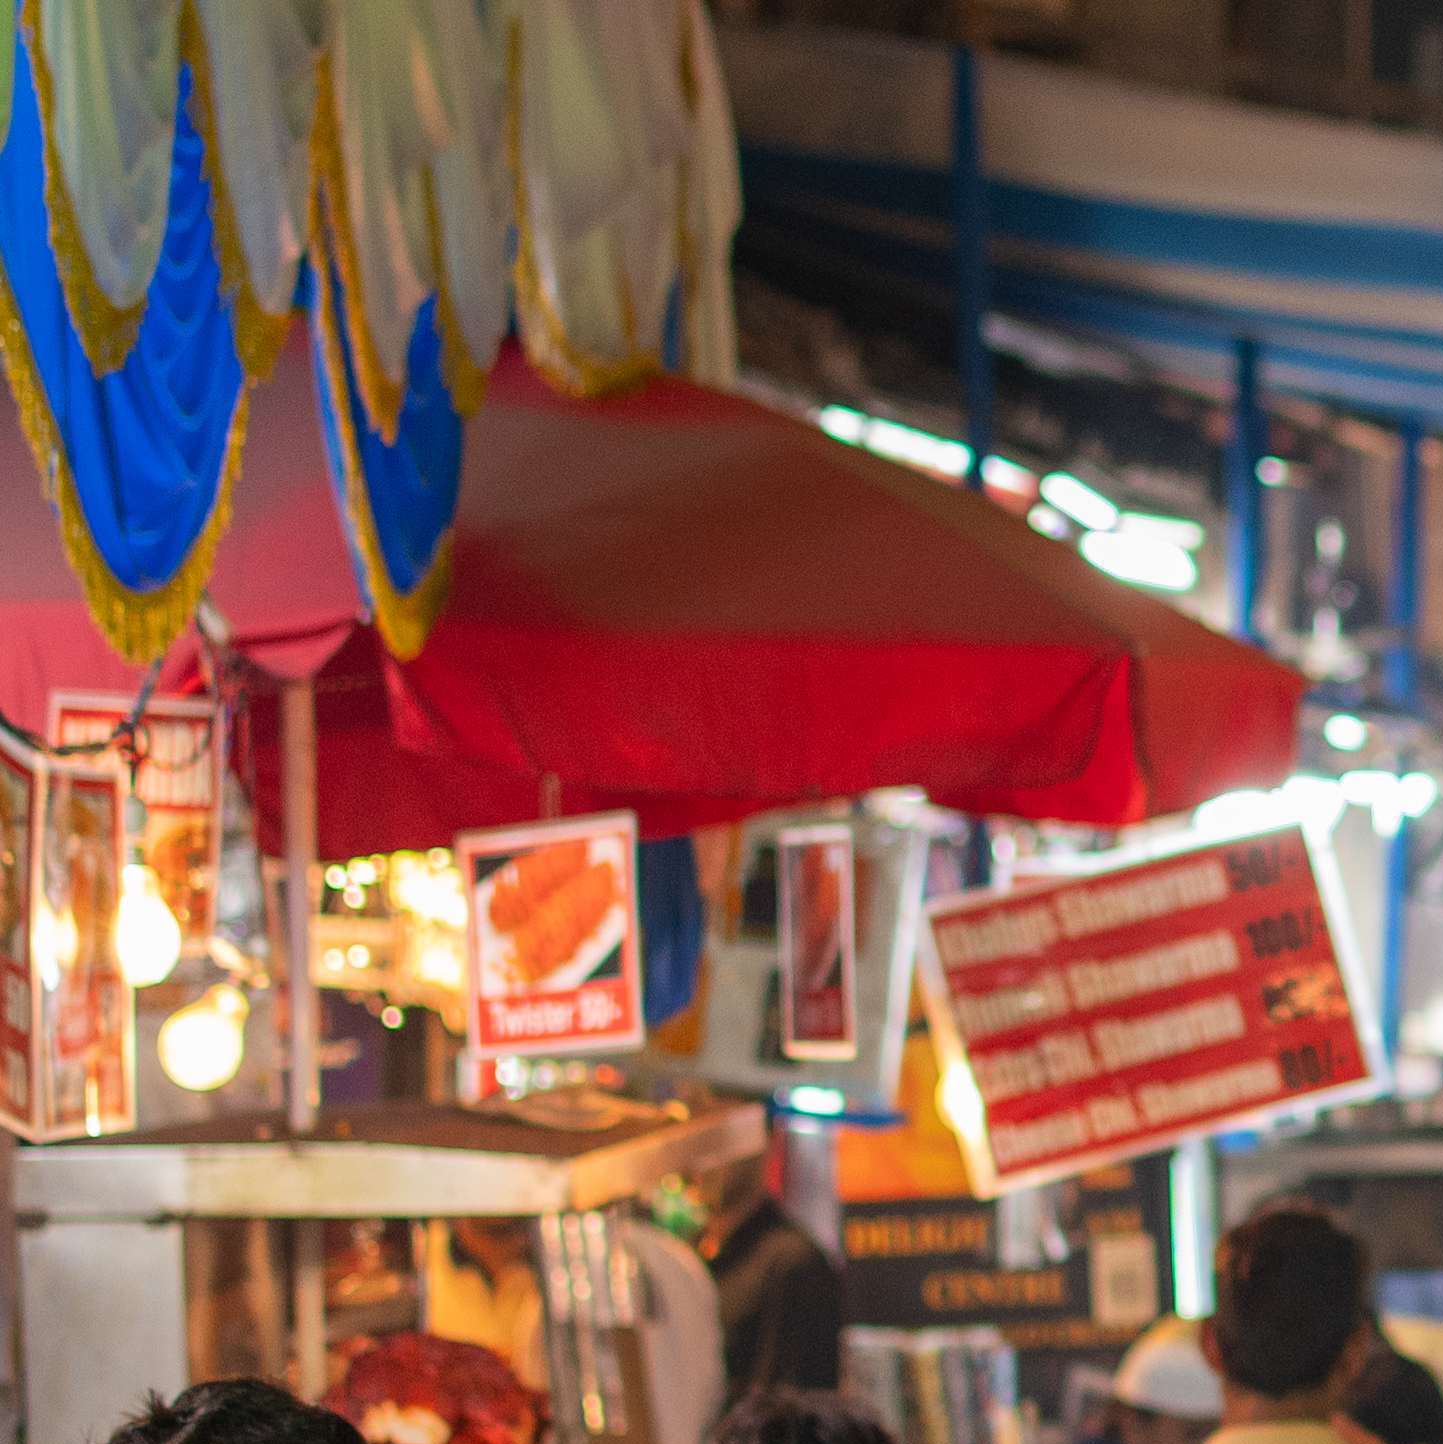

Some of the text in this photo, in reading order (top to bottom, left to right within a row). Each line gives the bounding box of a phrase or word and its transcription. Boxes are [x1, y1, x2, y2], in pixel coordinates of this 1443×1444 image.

[488, 999, 573, 1037] Twister
[845, 1216, 990, 1258] DELIGH
[923, 1269, 1065, 1311] CENTRE
